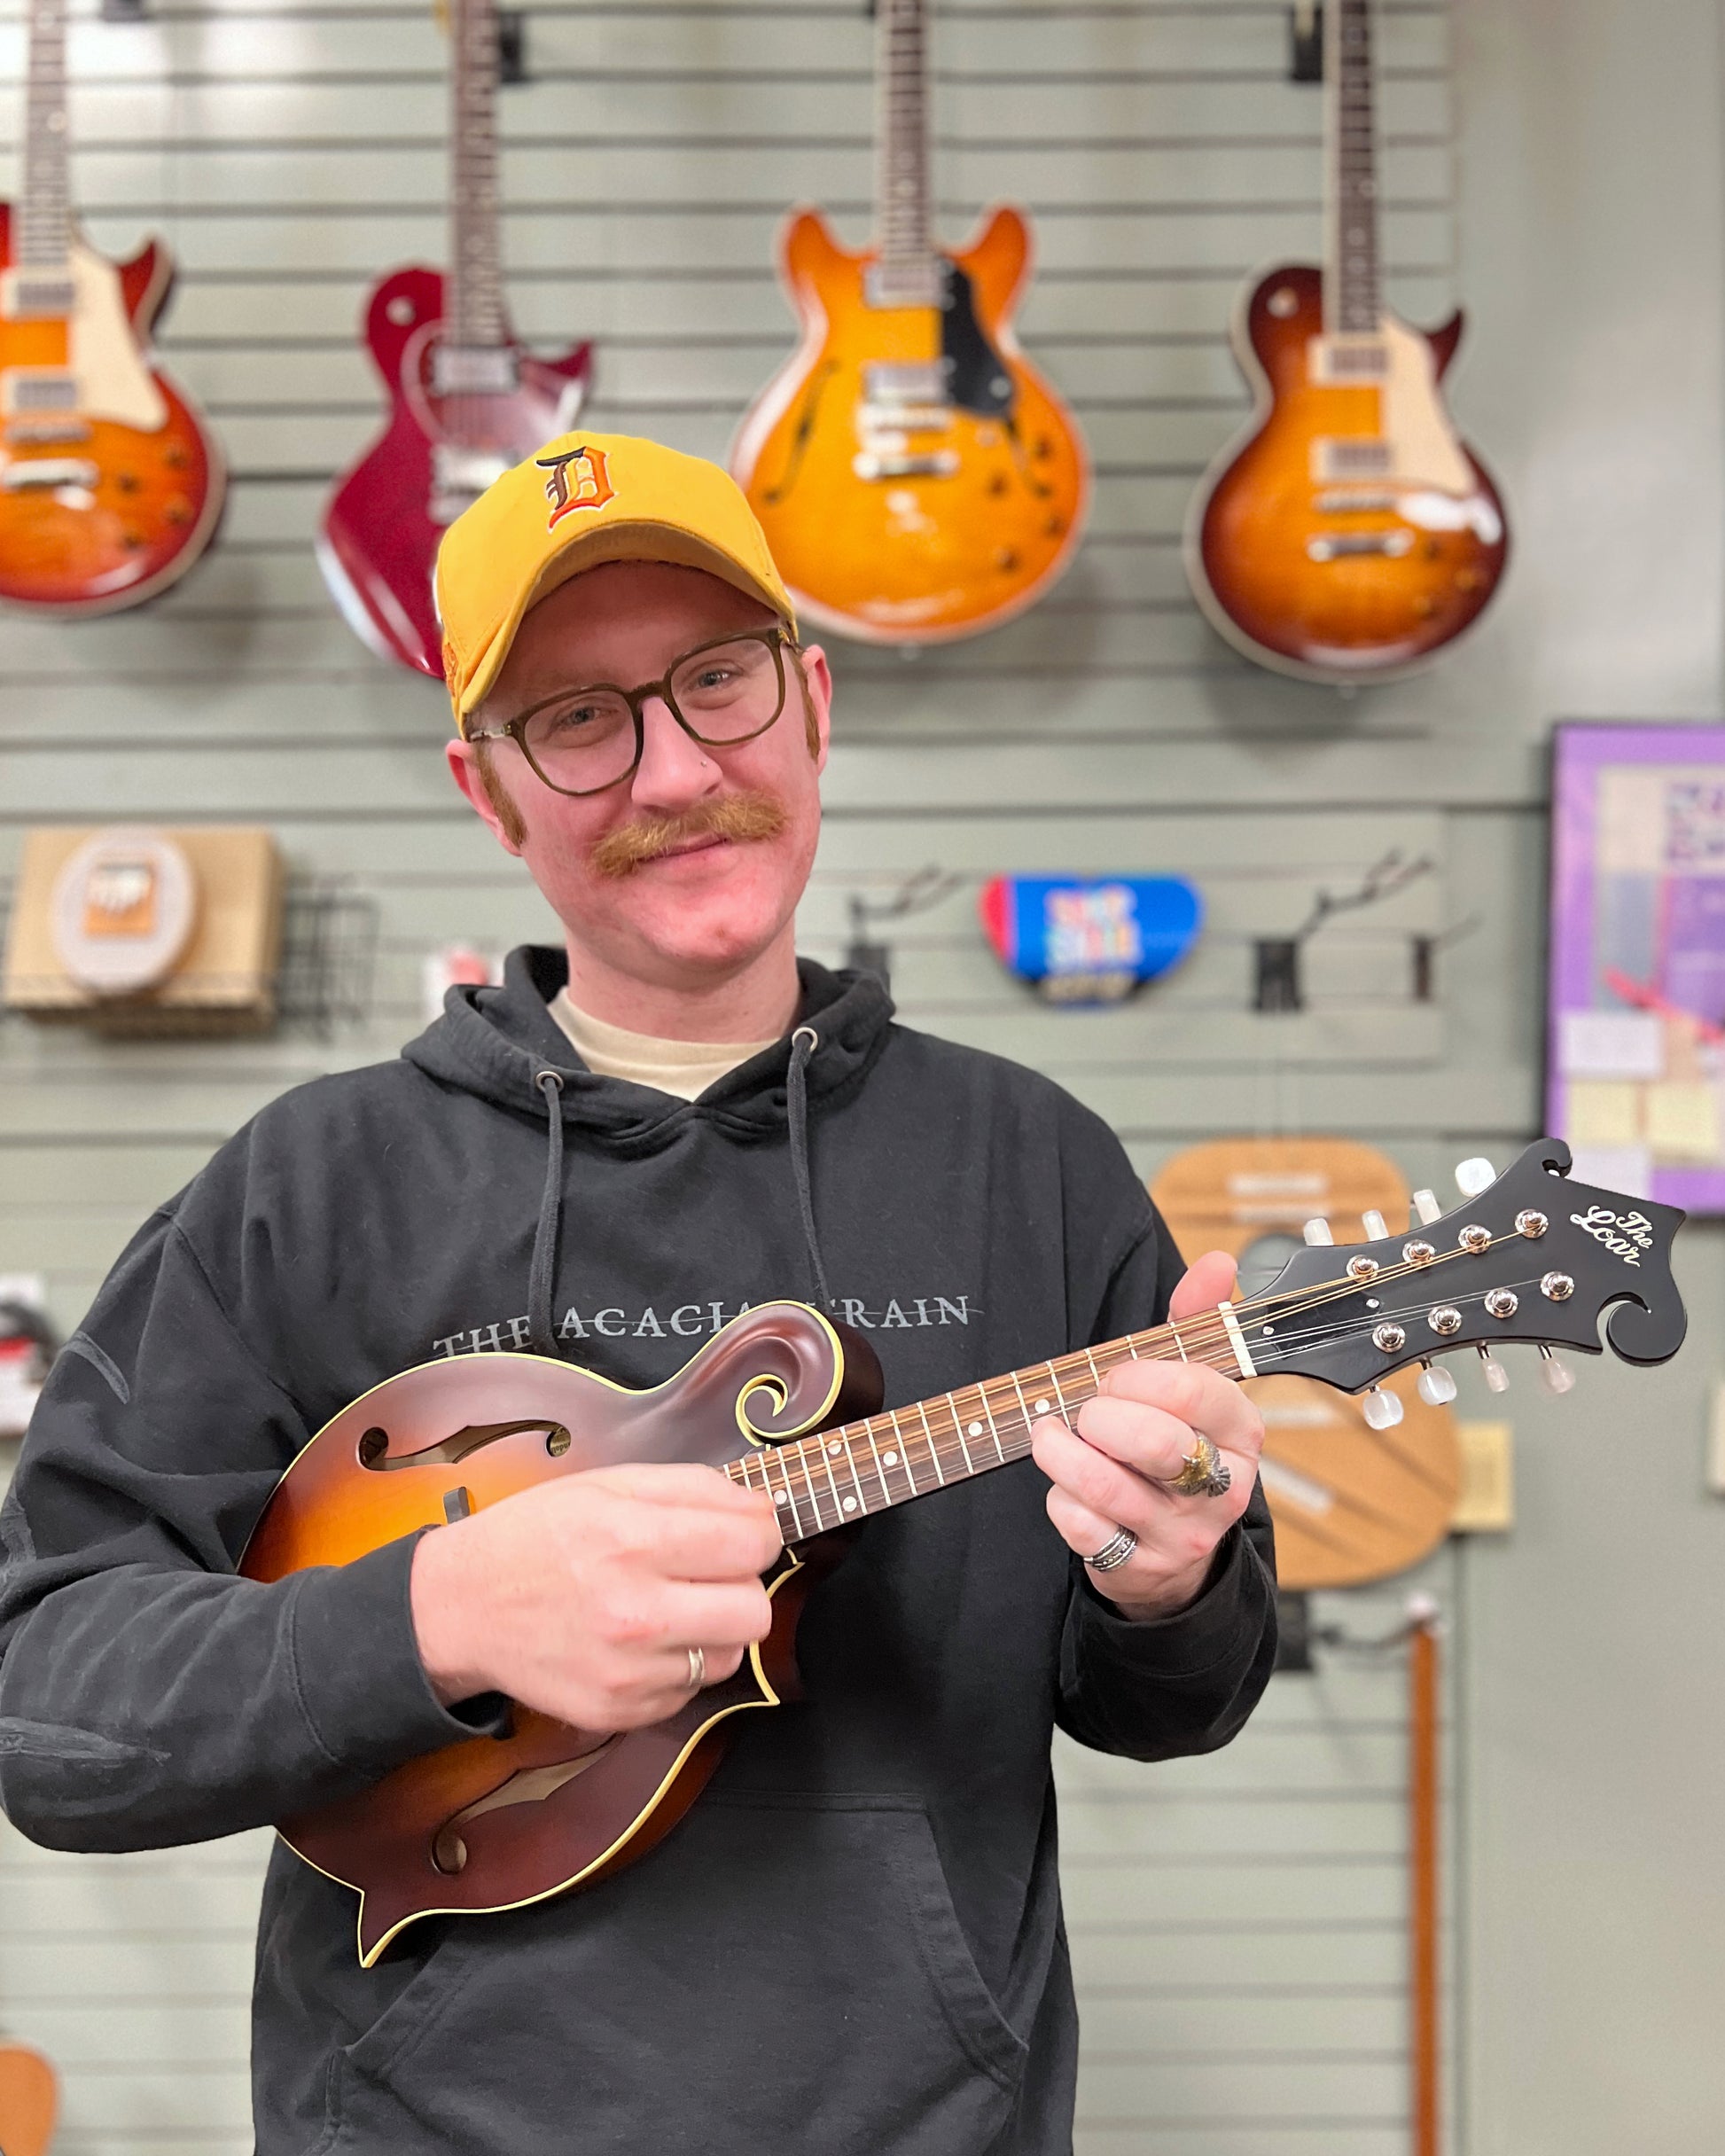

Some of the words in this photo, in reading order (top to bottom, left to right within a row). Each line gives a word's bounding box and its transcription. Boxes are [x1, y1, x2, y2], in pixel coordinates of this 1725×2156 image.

[535, 445, 618, 534] D
[1570, 1206, 1641, 1268] Loar
[1615, 1211, 1653, 1249] The
[433, 1316, 532, 1356] THE
[806, 1295, 969, 1328] RAIN
